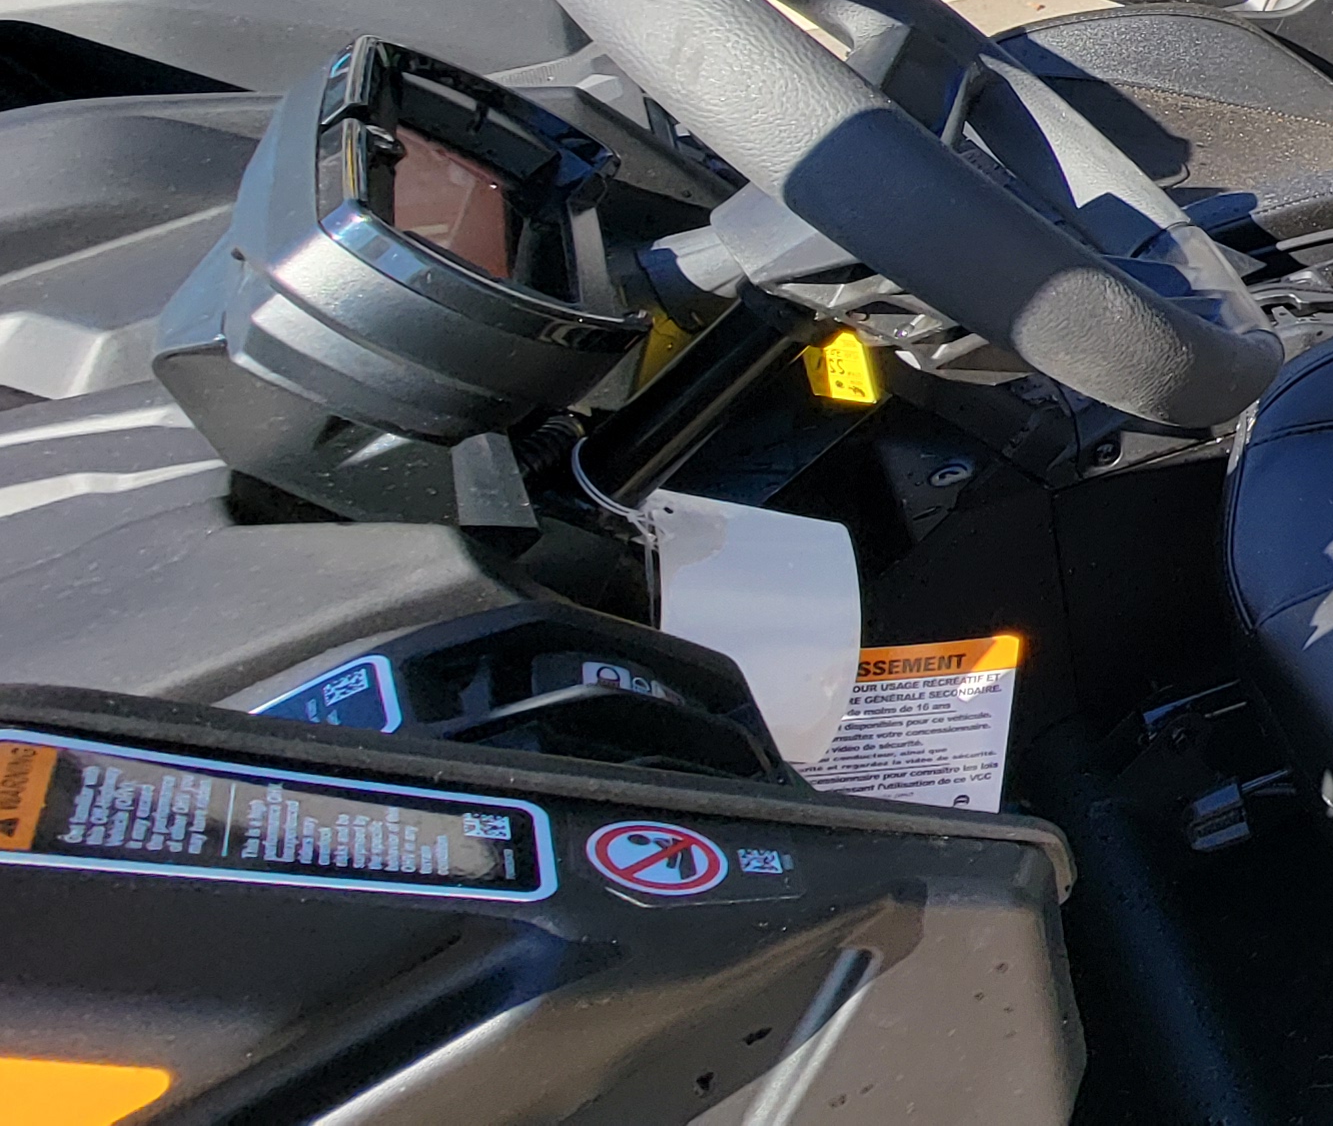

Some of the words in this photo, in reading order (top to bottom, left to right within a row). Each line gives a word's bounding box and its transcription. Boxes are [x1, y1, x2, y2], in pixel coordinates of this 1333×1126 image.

[857, 653, 967, 677] SSEMENT
[852, 684, 878, 694] OUR
[880, 681, 920, 692] USAGE
[986, 673, 1001, 682] ET
[863, 707, 897, 716] moins
[899, 704, 913, 713] de
[916, 703, 930, 712] 16
[931, 703, 951, 711] ans
[844, 720, 904, 731] disponibles
[905, 718, 930, 728] pour
[876, 731, 903, 739] votre
[862, 743, 876, 752] de
[882, 771, 908, 781] pour
[962, 763, 977, 772] les
[980, 761, 999, 770] lois
[937, 777, 951, 786] de
[953, 776, 966, 784] ce
